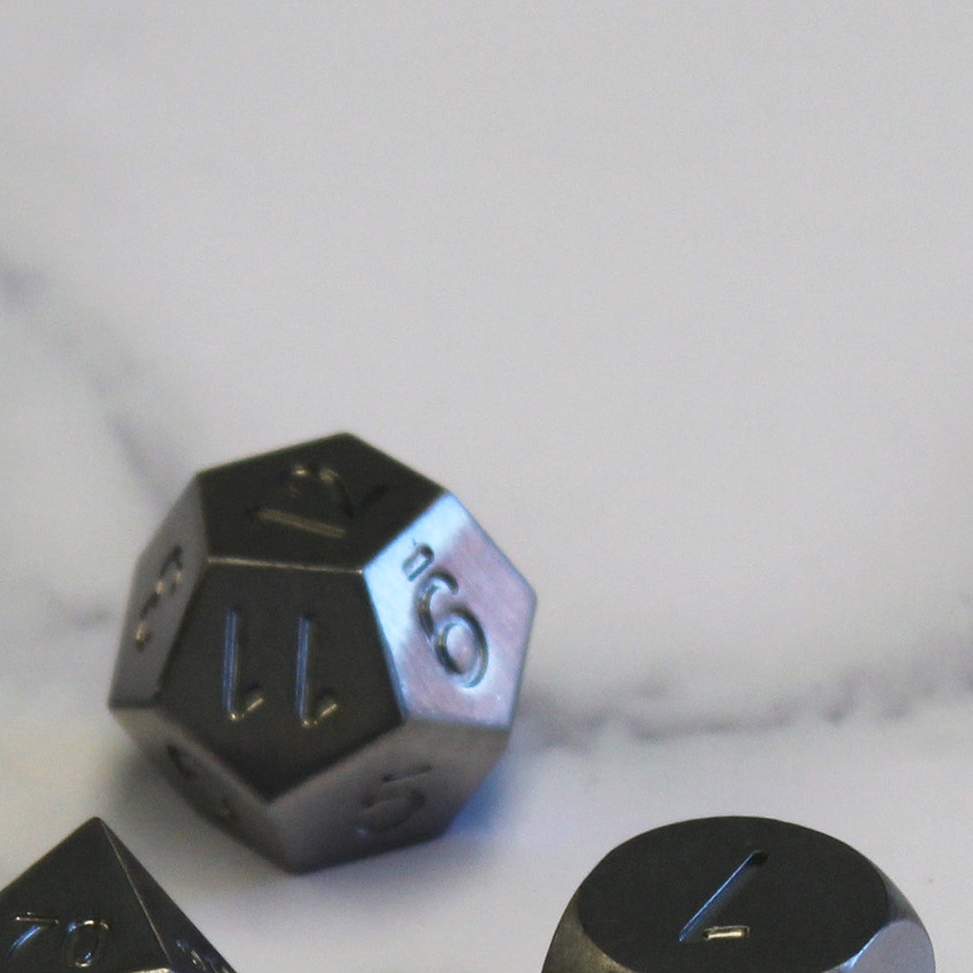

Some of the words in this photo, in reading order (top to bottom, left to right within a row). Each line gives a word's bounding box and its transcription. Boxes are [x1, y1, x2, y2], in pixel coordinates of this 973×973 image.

[222, 605, 337, 728] 11
[5, 911, 111, 968] 70
[678, 850, 769, 944] 1
